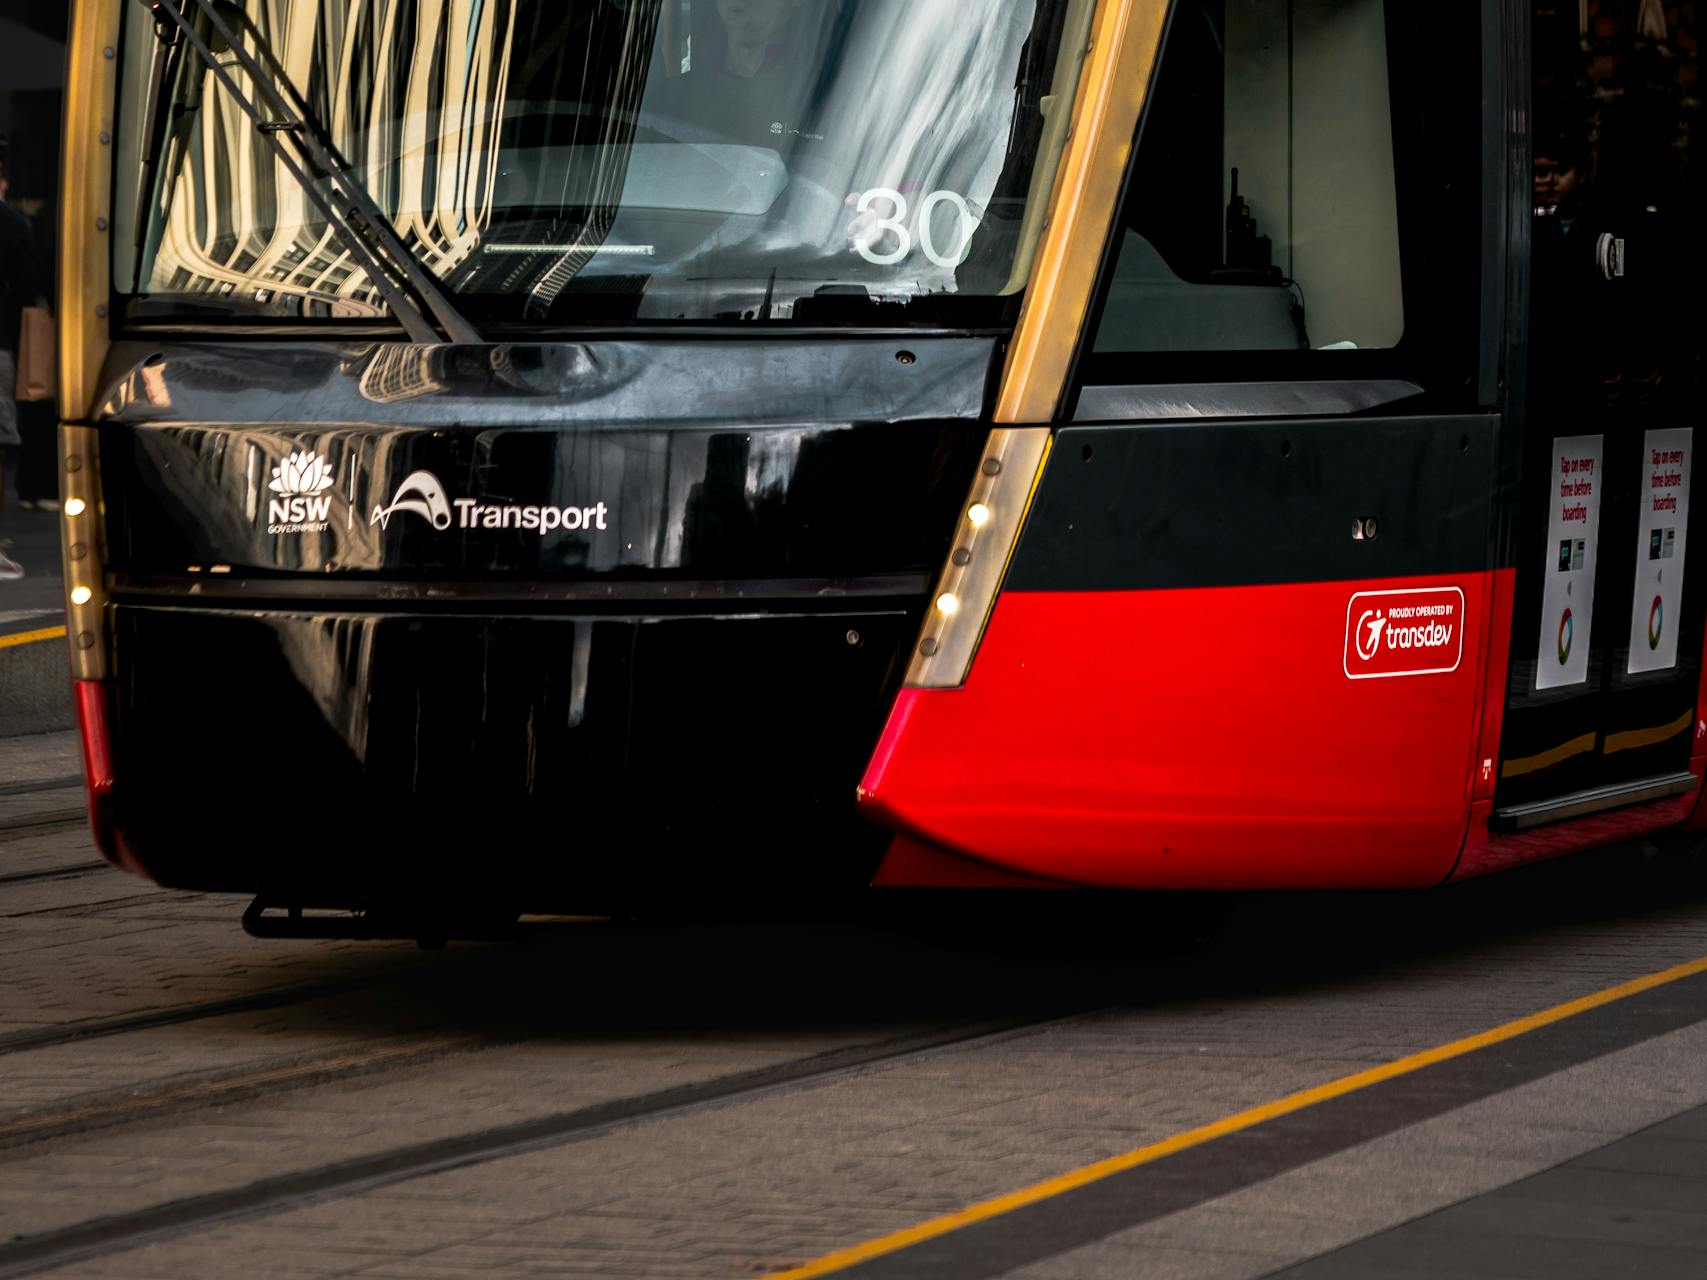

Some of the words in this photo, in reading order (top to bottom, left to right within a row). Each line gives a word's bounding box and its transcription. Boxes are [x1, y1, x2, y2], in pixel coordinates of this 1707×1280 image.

[856, 187, 973, 268] 30
[1561, 456, 1571, 477] Tap
[1571, 459, 1579, 473] on
[1579, 458, 1595, 476] every
[1652, 449, 1661, 470] Tap
[1661, 451, 1669, 464] on
[1669, 449, 1684, 467] every
[1561, 479, 1573, 497] time
[1573, 478, 1592, 496] before
[1664, 469, 1682, 487] before
[269, 496, 332, 524] NSW
[1562, 502, 1587, 524] boarding
[1653, 493, 1677, 514] boarding
[453, 498, 608, 535] Transport
[267, 522, 329, 535] GOVERNMENT
[1389, 608, 1415, 618] PROUDLY
[1416, 606, 1445, 617] OPERATED
[1446, 605, 1453, 615] BY
[1386, 619, 1453, 649] transdev
